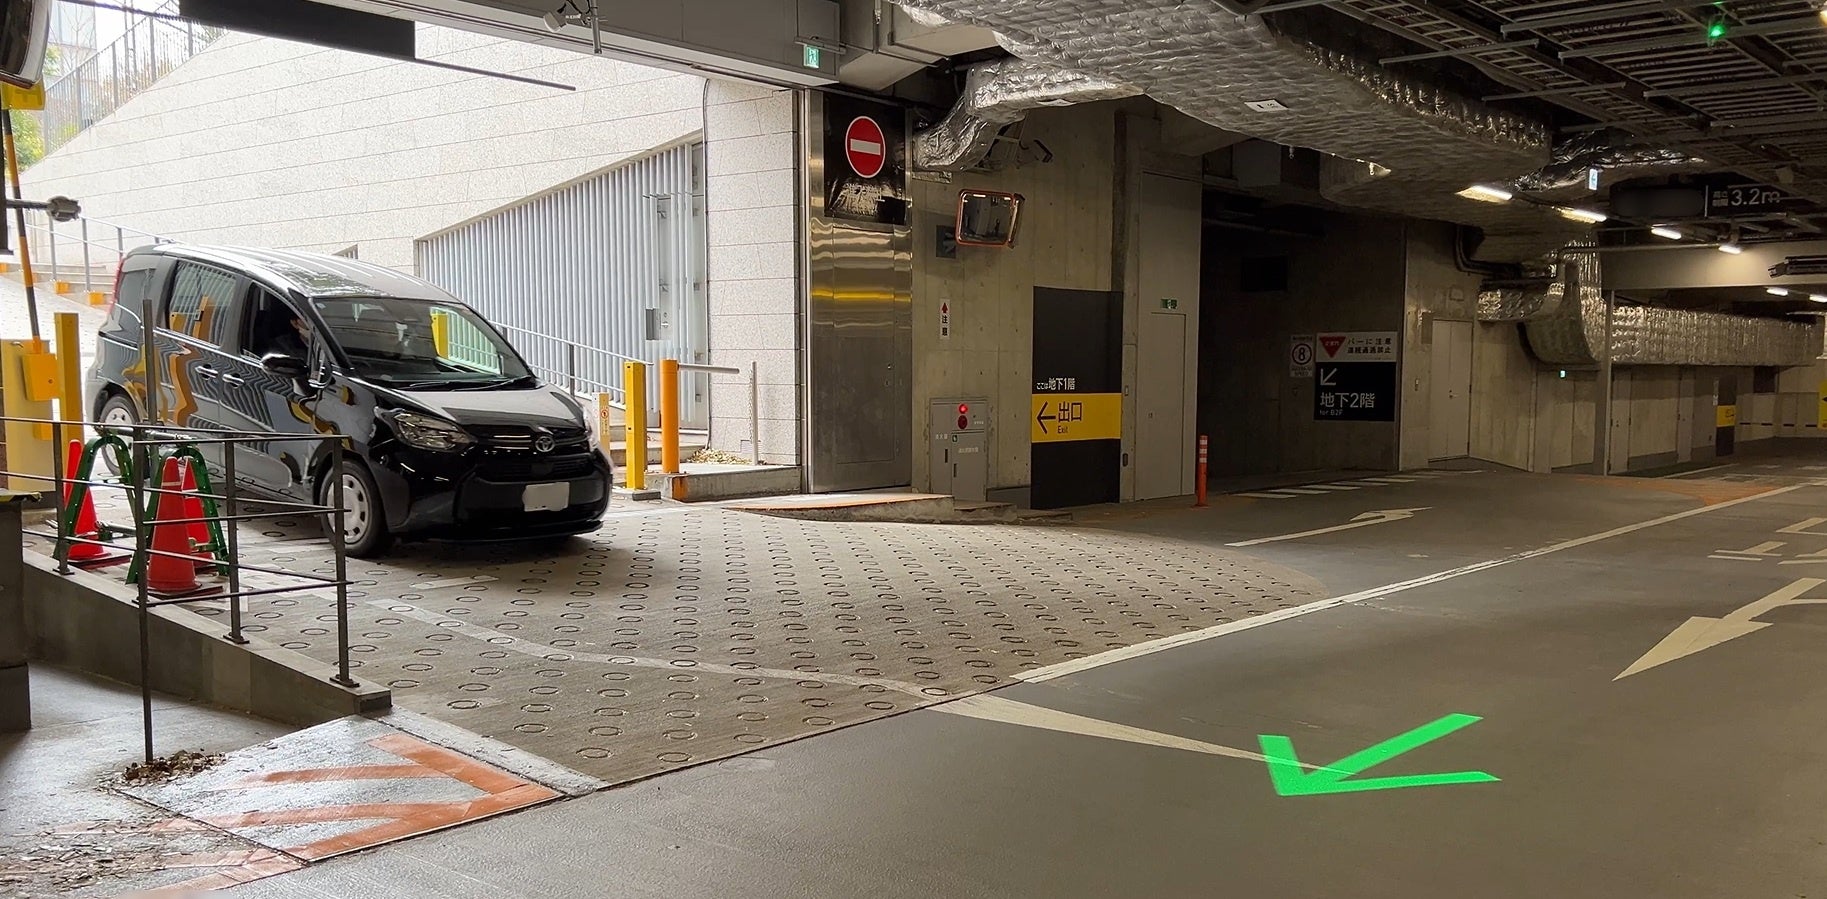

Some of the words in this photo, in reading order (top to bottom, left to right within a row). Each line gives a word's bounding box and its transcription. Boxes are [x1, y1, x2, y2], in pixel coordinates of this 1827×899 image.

[941, 315, 949, 336] 注意
[1298, 347, 1306, 361] 8
[1319, 392, 1376, 408] 地下2階
[1058, 401, 1082, 422] 出口
[1057, 425, 1069, 434] Exit
